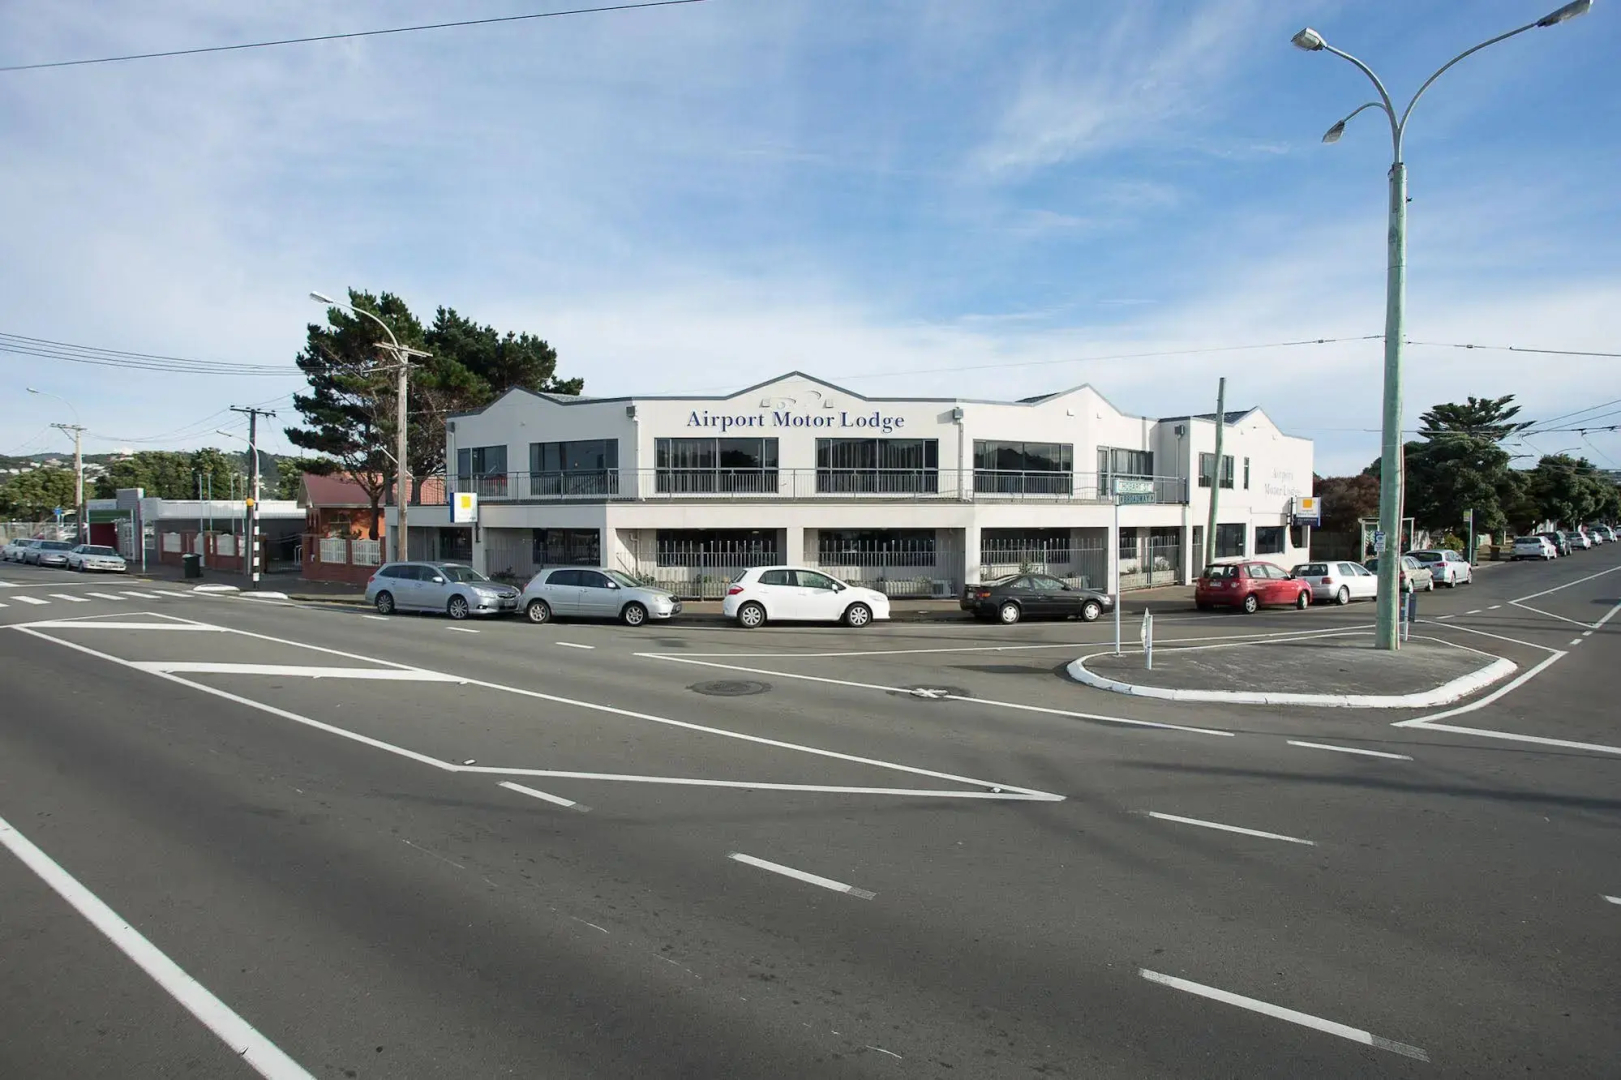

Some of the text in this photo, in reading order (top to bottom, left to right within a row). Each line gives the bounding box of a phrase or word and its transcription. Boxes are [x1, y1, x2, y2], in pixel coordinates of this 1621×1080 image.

[687, 410, 905, 433] Airport Motor Lodge
[1271, 467, 1294, 483] Airport
[1264, 483, 1282, 496] Motor
[1123, 494, 1149, 503] BROADWAY
